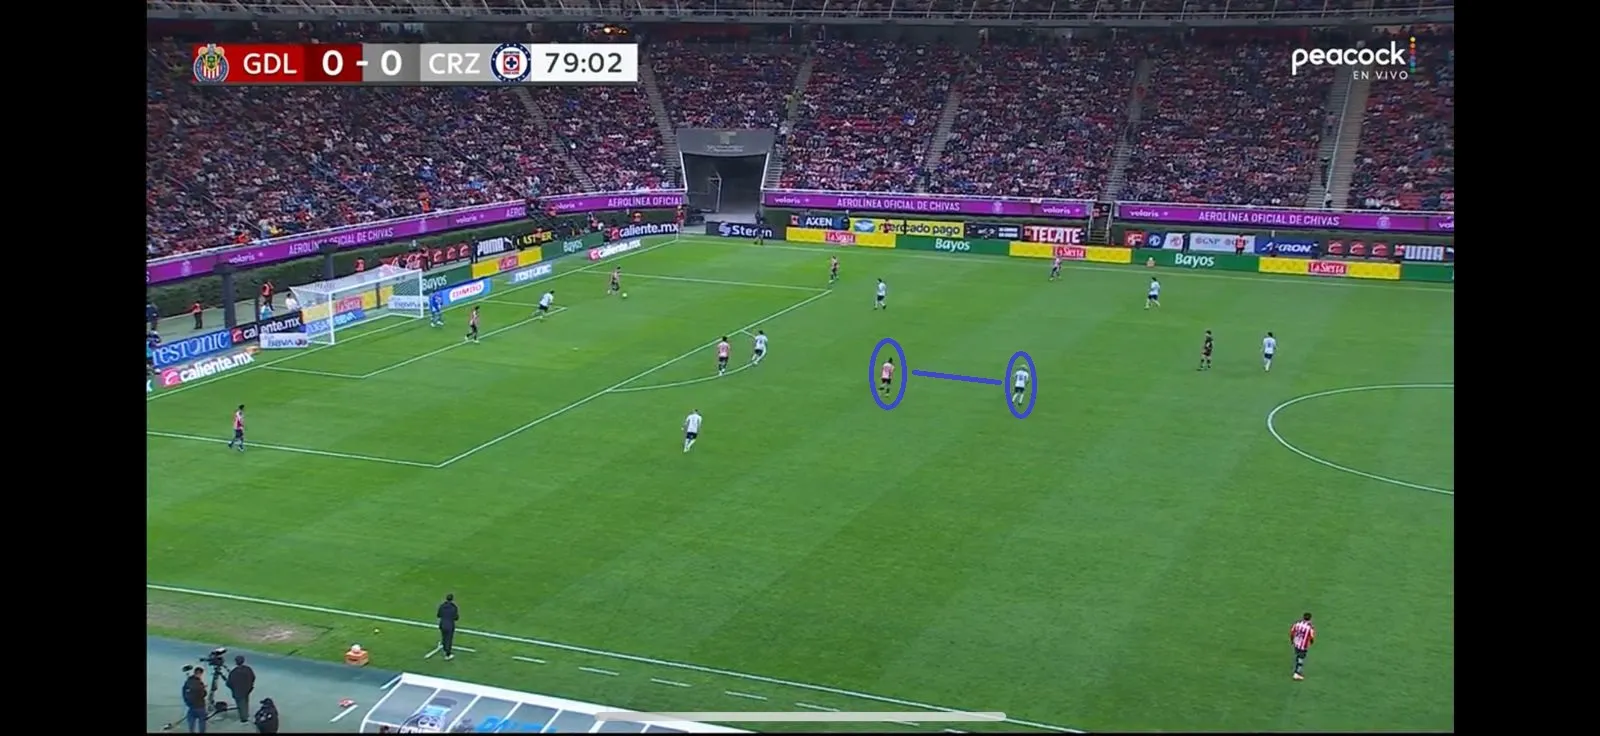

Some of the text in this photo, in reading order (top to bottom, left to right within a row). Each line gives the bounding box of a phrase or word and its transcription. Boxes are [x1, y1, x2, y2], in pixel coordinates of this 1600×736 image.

[884, 200, 914, 209] OFICIAL
[917, 201, 927, 210] DE
[929, 201, 960, 211] CHIVAS
[805, 216, 833, 226] AXEN
[1251, 213, 1287, 224] OFICIAL
[1289, 214, 1302, 225] DE
[1303, 215, 1340, 226] CHIVAS
[356, 232, 367, 243] DE
[367, 227, 394, 241] CHIVAS
[619, 222, 678, 238] caliente.mx
[932, 227, 960, 237] pago
[1031, 225, 1081, 244] TECATE
[935, 238, 971, 252] Bayos
[1403, 244, 1445, 261] UMA
[1174, 253, 1215, 268] Bayos
[242, 316, 300, 340] calente.mx
[179, 351, 255, 382] caliente.mx
